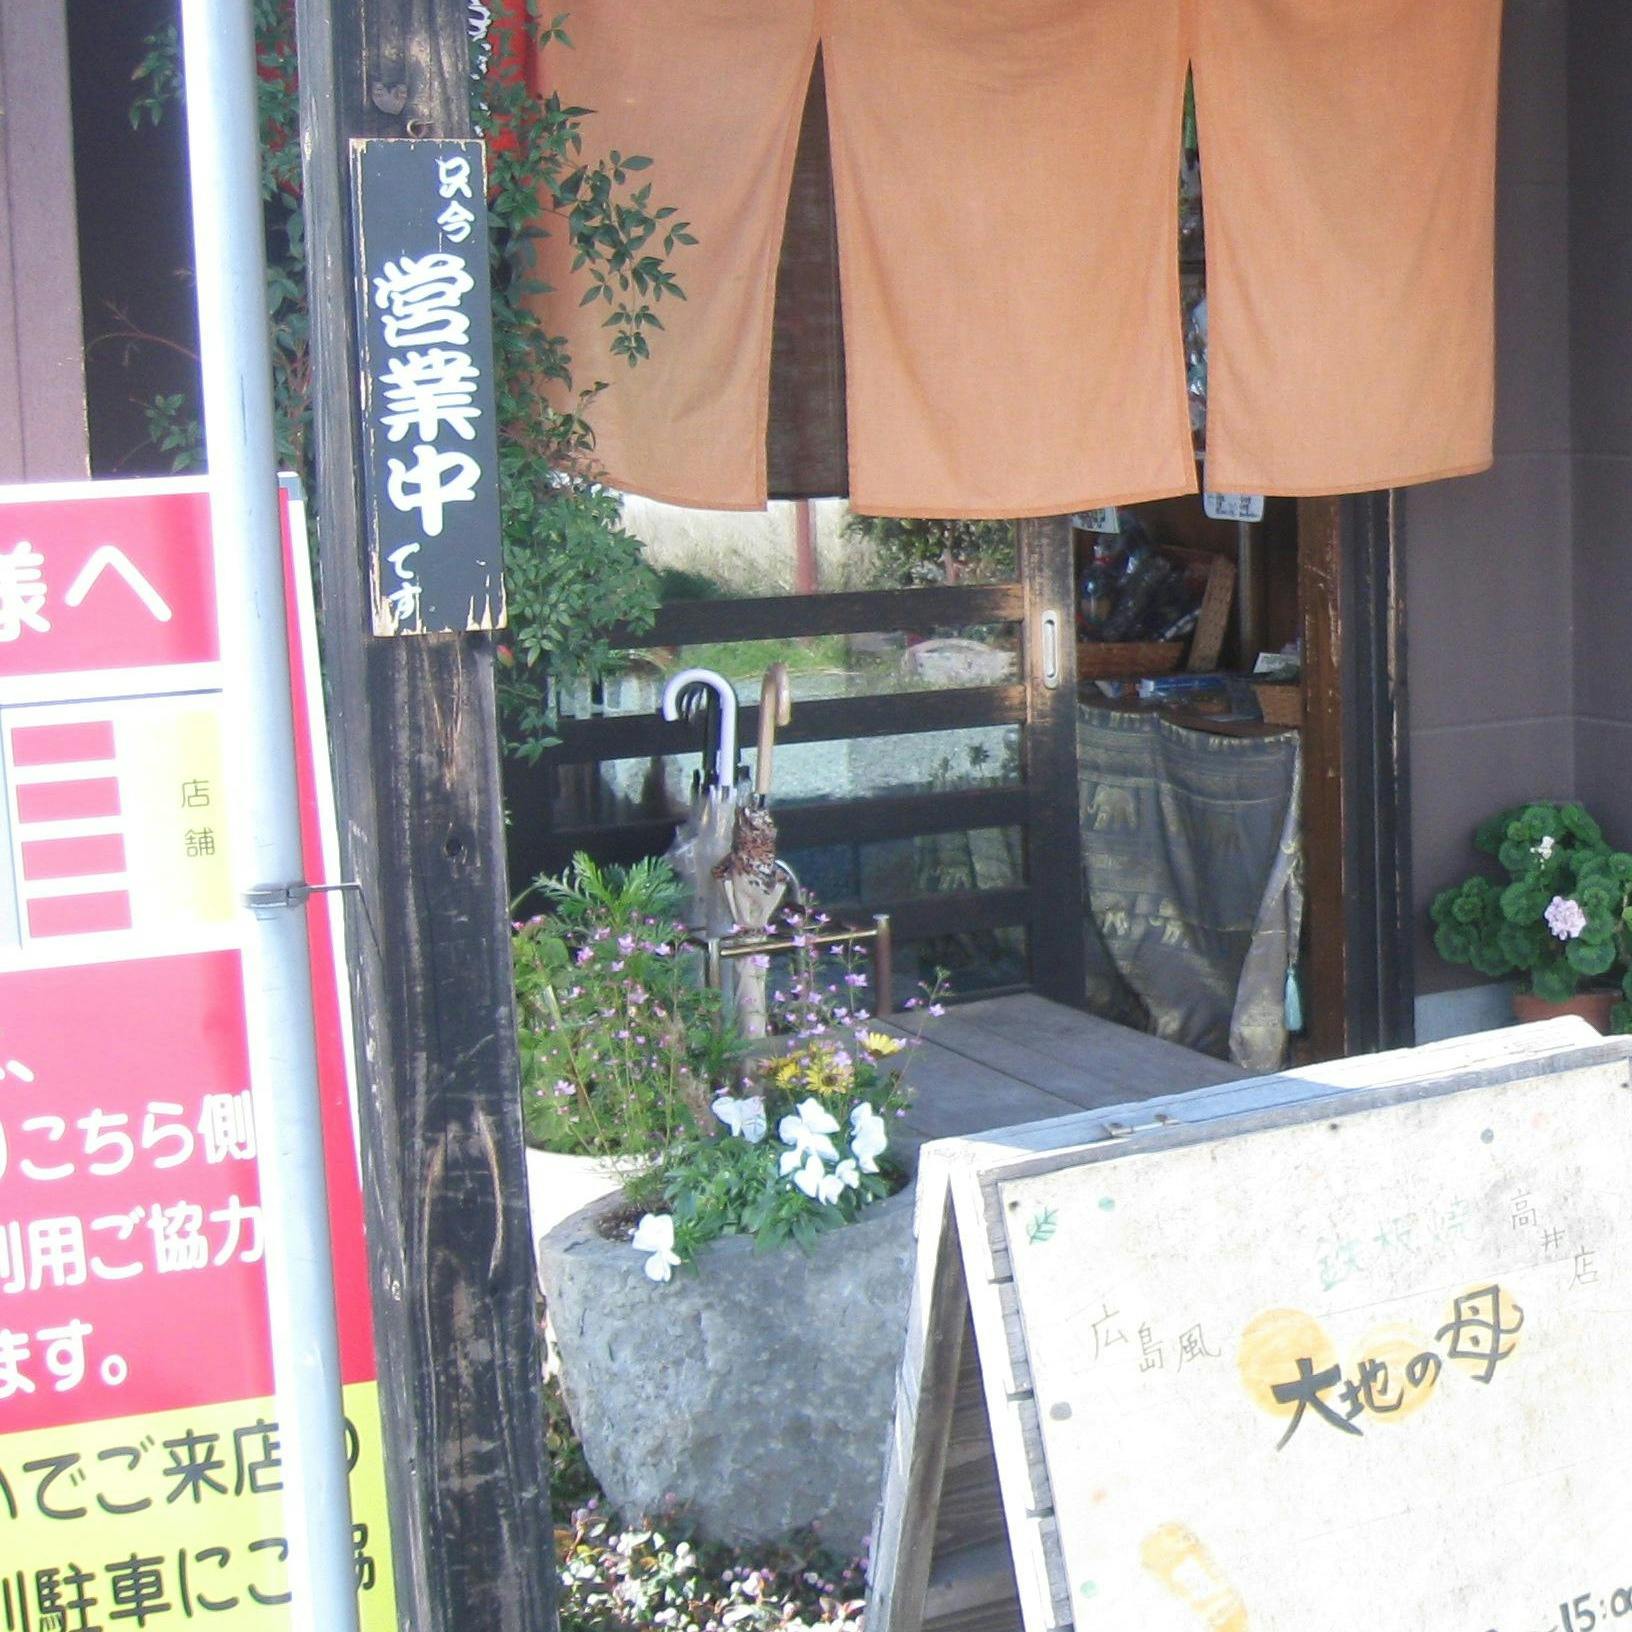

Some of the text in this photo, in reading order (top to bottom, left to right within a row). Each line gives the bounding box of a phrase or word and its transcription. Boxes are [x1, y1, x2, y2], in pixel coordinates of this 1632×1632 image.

[181, 779, 216, 858] 店舗
[0, 1090, 257, 1180] こちら側
[1271, 1284, 1524, 1451] 大地の母
